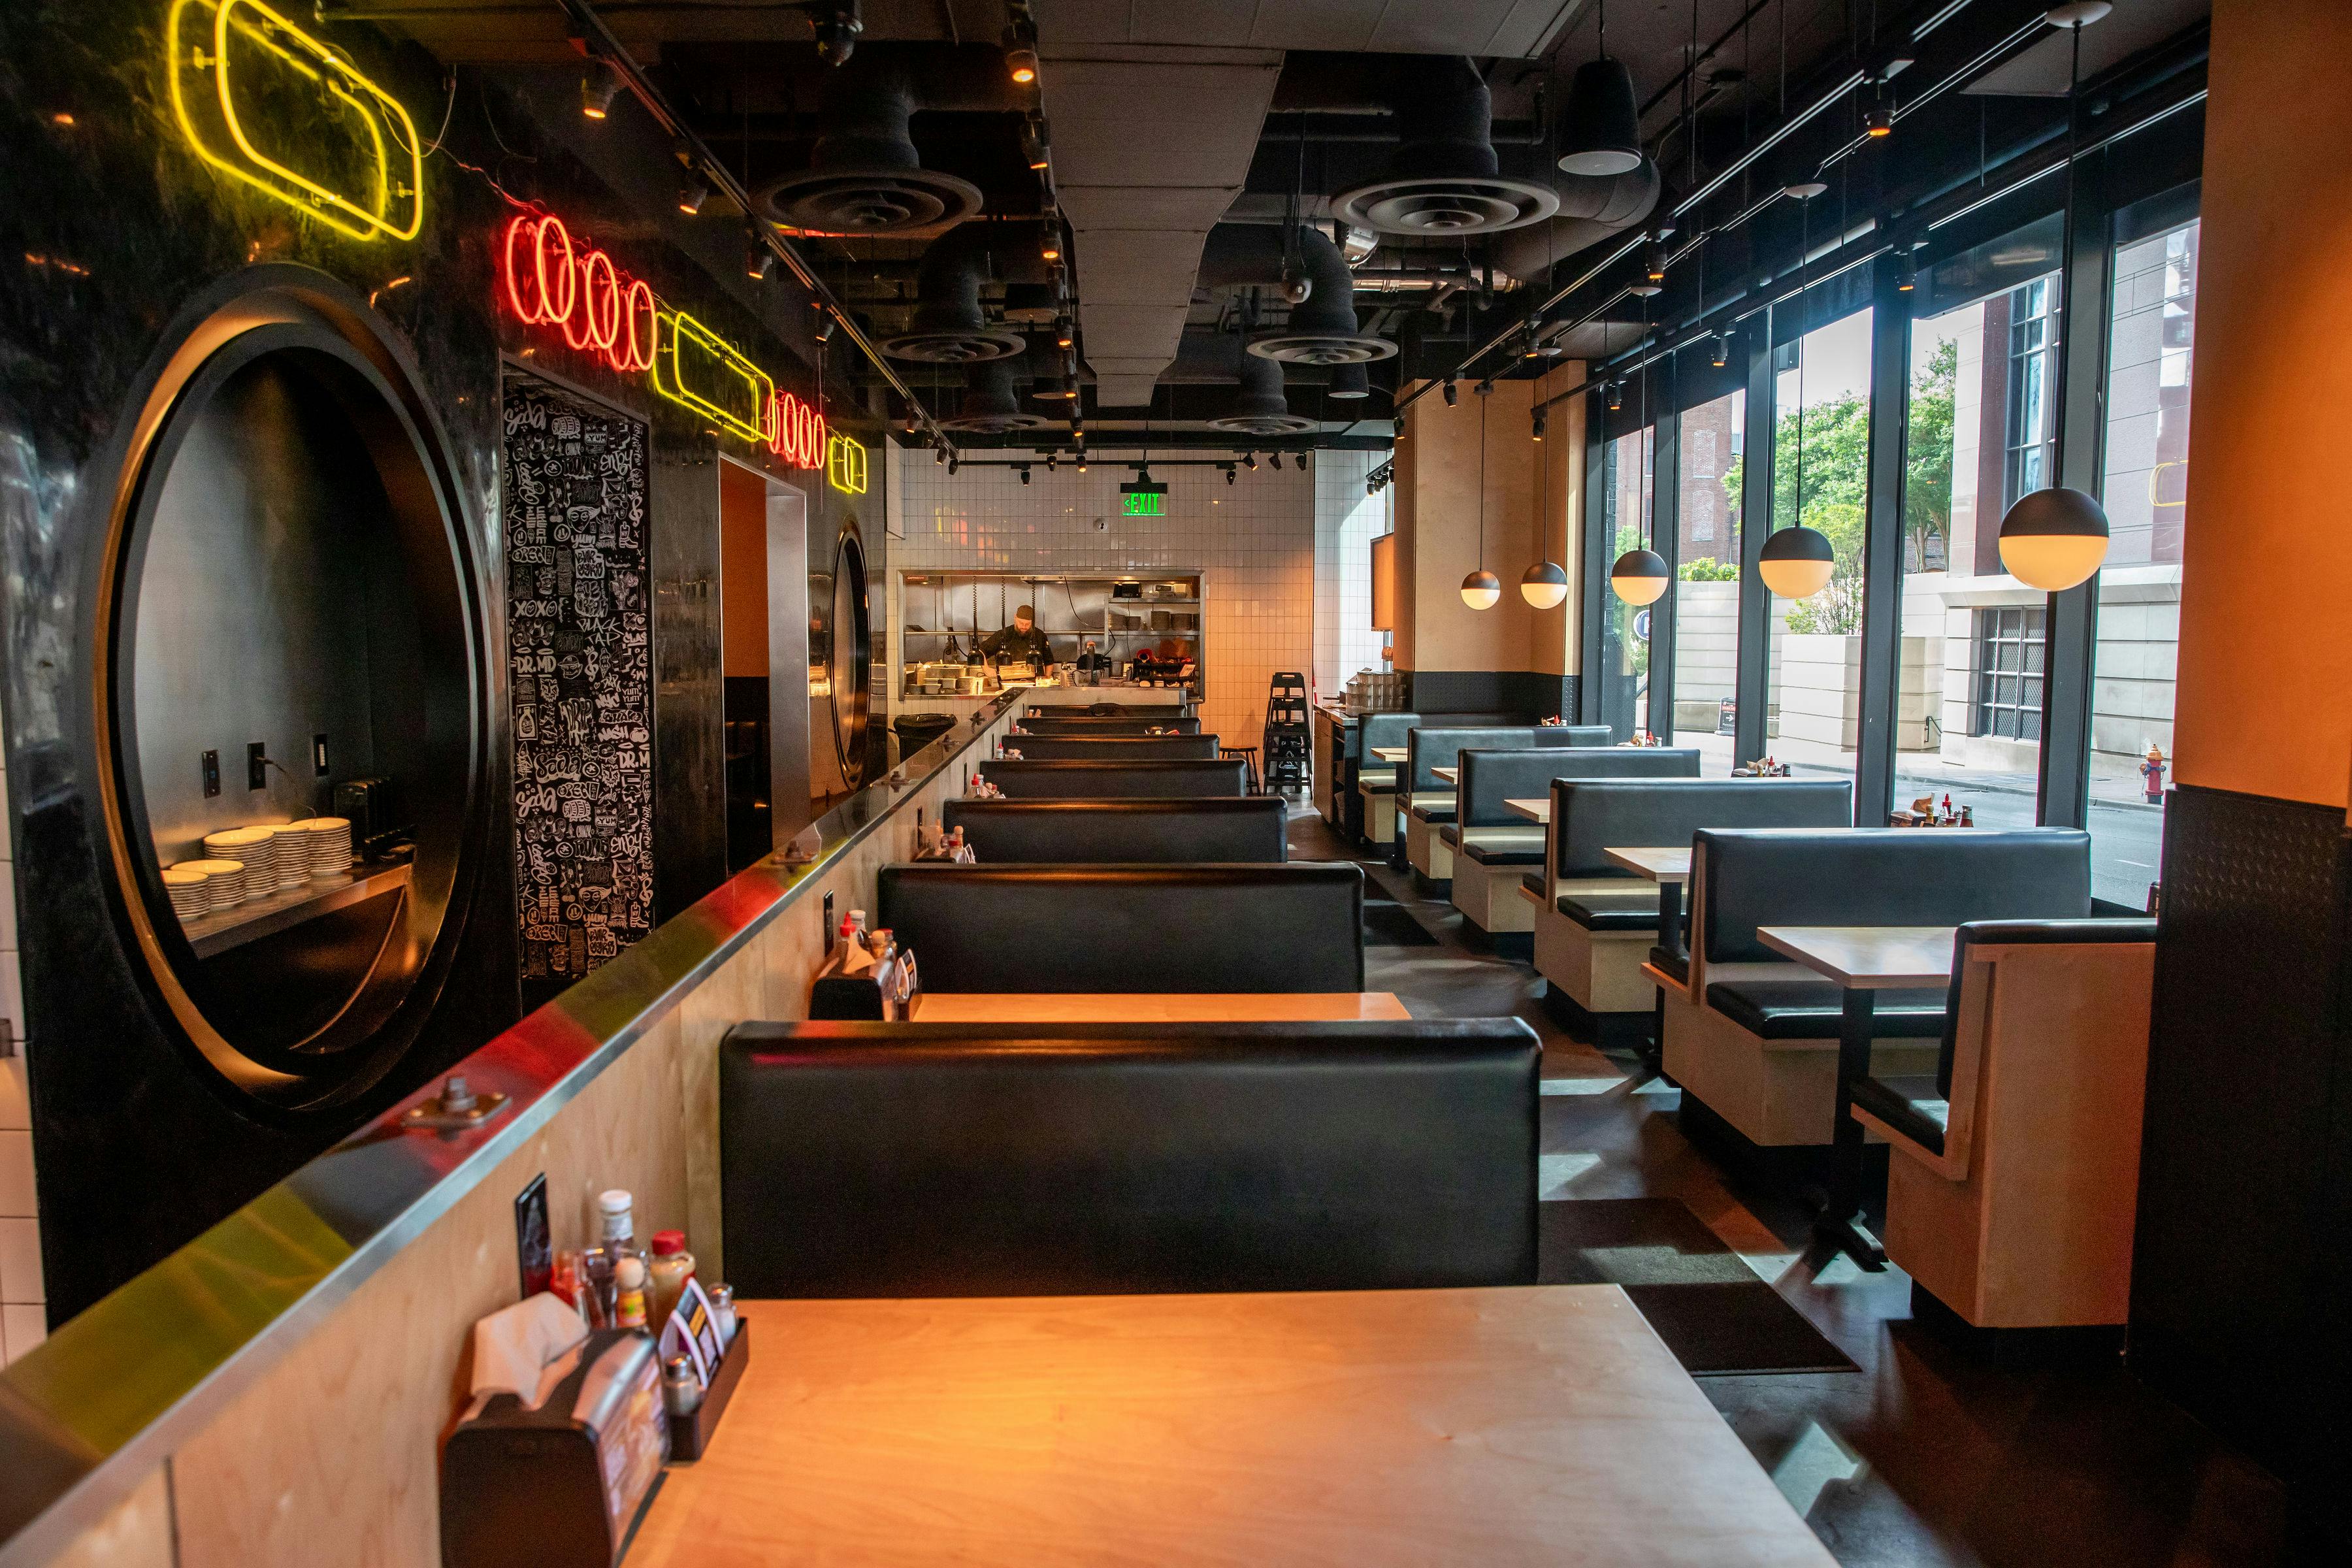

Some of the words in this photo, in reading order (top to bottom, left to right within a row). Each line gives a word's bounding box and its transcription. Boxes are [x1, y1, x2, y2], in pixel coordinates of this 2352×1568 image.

[1130, 493, 1159, 513] EXIT
[514, 600, 558, 617] XOXO
[576, 617, 625, 635] BLACK
[584, 632, 621, 647] TAP
[514, 655, 536, 674] DR.
[536, 655, 557, 674] MD
